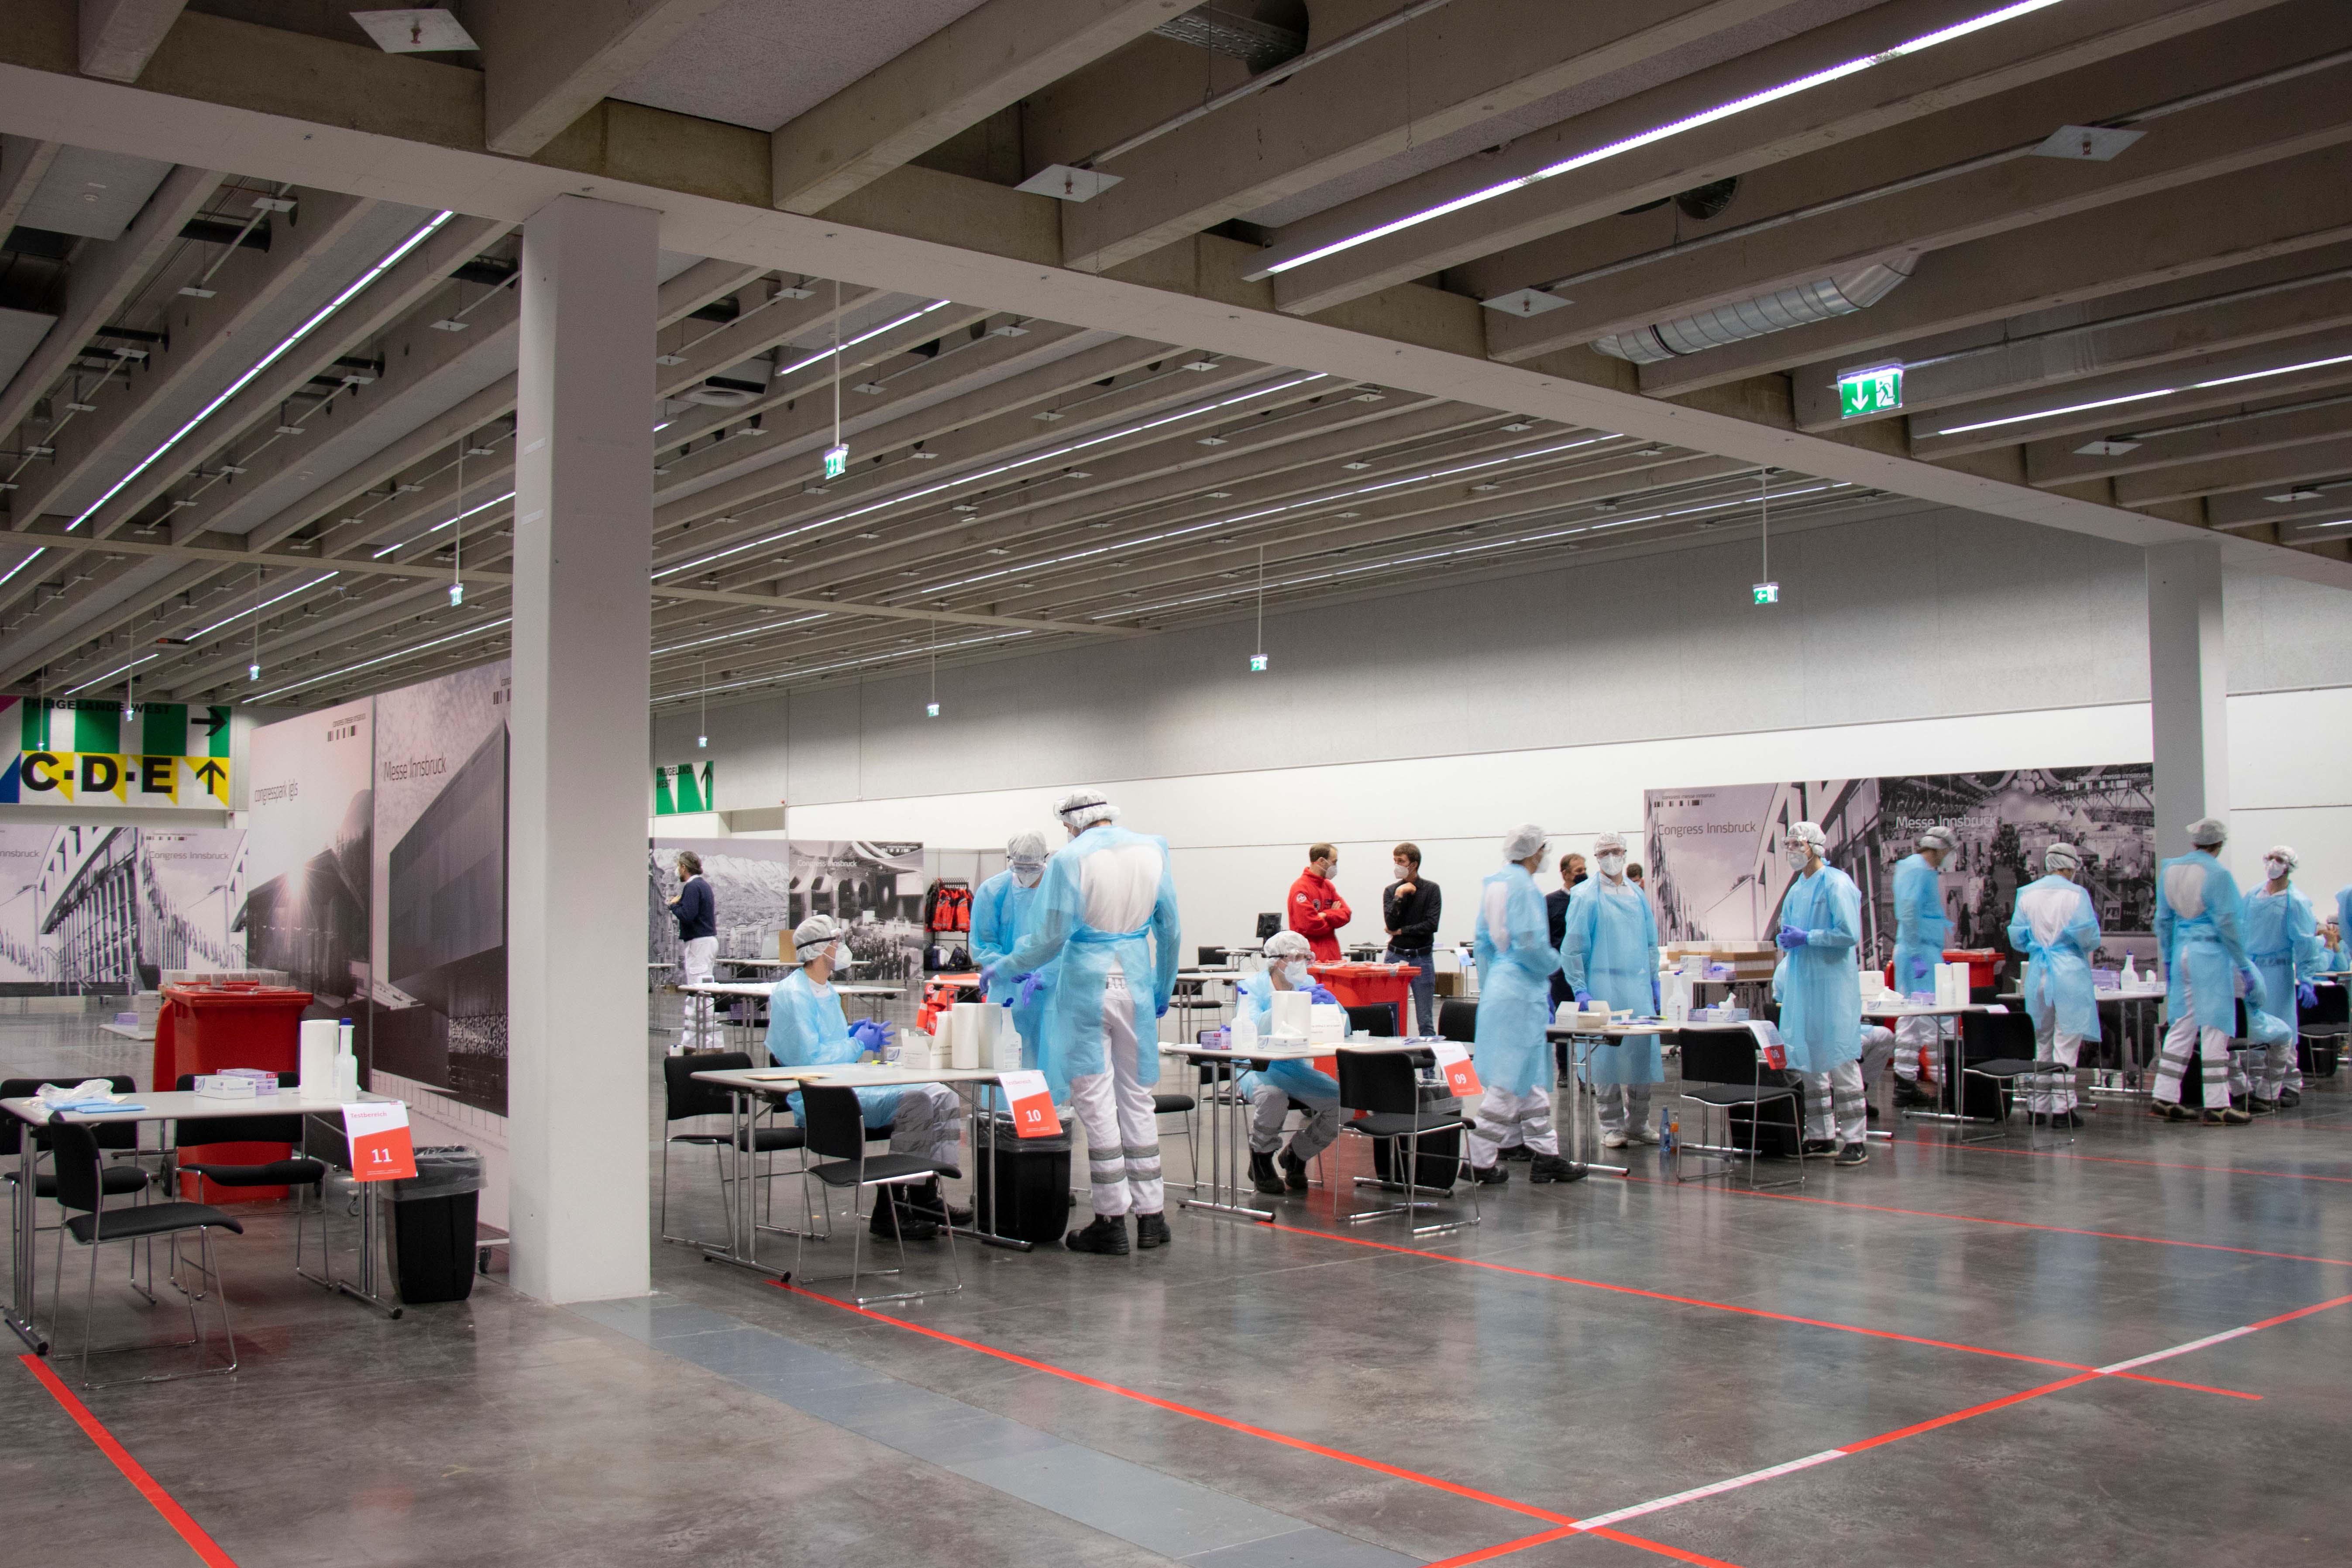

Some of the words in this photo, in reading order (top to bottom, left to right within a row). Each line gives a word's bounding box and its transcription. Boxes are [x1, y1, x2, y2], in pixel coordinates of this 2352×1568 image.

[132, 703, 171, 714] WEST
[384, 761, 407, 781] Messe
[410, 751, 447, 779] Innsbruck
[656, 779, 671, 789] WEST
[254, 780, 287, 805] congresspark
[289, 778, 298, 801] igls
[1895, 815, 1935, 829] Messe
[1939, 814, 1997, 827] Innsbruck
[1658, 824, 1703, 838] Congress
[1707, 821, 1756, 834] Innsbruck
[149, 851, 188, 860] Congress
[798, 859, 826, 867] Congress
[1770, 1049, 1780, 1059] 08
[1454, 1073, 1467, 1084] 09
[1025, 1109, 1042, 1122] 10
[371, 1148, 393, 1163] 11
